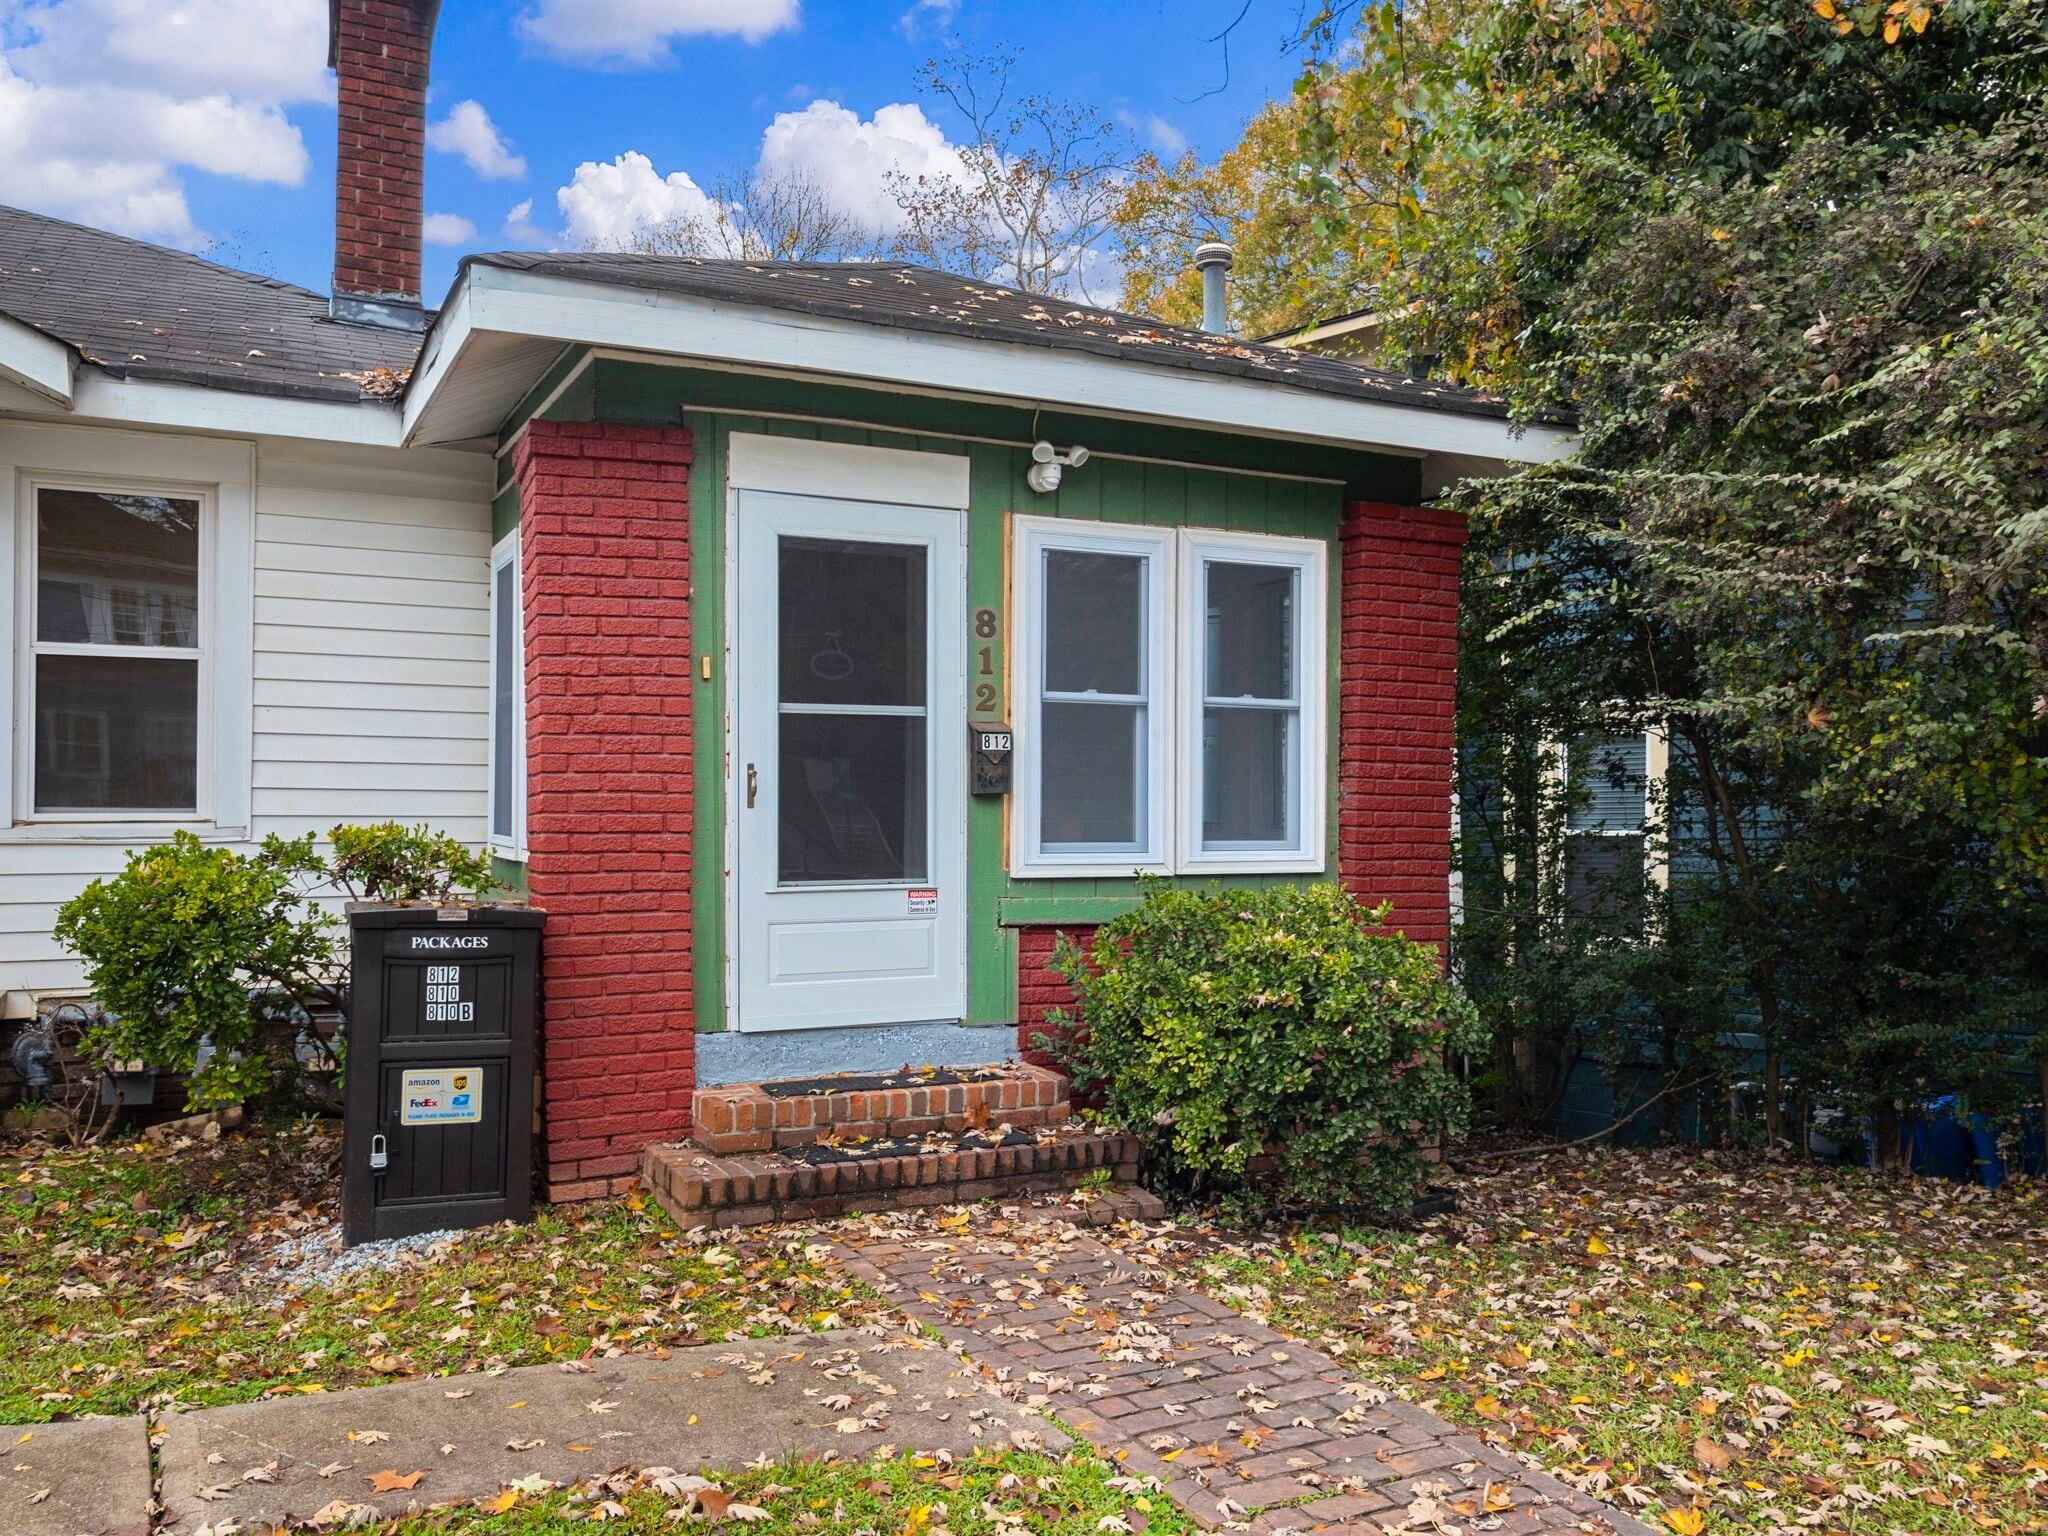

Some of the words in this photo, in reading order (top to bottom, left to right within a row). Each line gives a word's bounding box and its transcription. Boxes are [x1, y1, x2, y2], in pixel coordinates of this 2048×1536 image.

[975, 609, 997, 712] 812
[983, 736, 1009, 749] 812
[411, 936, 489, 949] PACKAGES
[429, 967, 458, 982] 812
[428, 985, 457, 1001] 810
[428, 1004, 471, 1021] 810B
[408, 1079, 440, 1087] amazon
[455, 1079, 467, 1088] ups
[410, 1098, 438, 1107] FedEx
